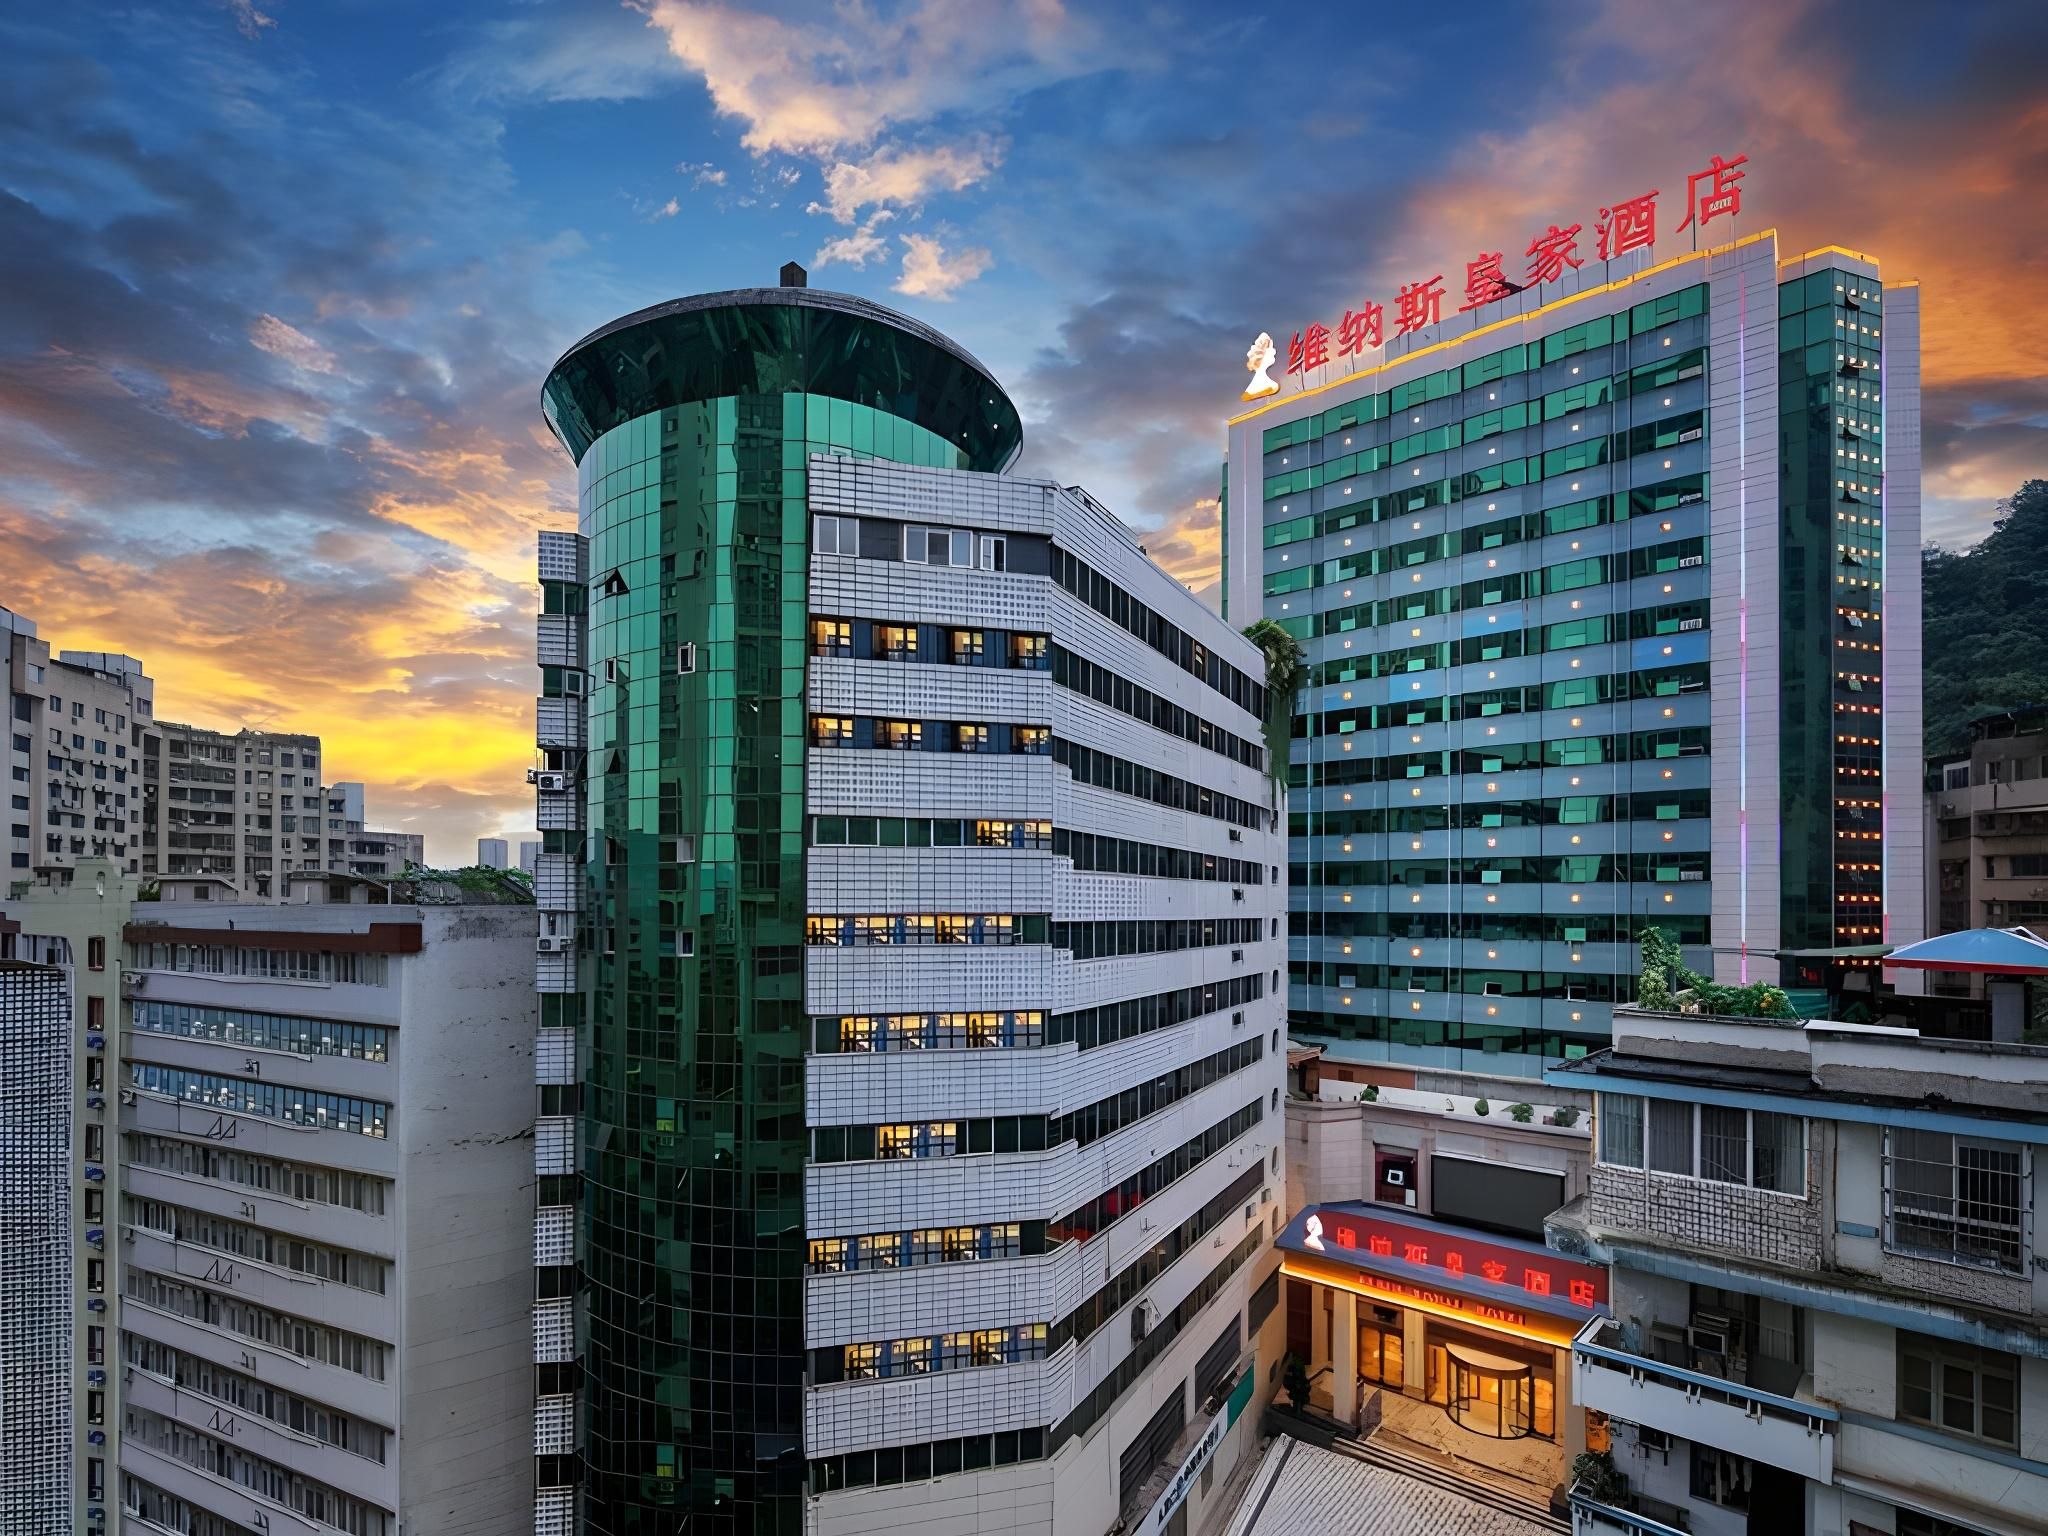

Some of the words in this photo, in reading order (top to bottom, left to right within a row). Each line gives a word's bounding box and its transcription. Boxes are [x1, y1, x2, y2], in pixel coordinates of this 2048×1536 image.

[1287, 154, 1748, 375] 维纳斯皇家酒店
